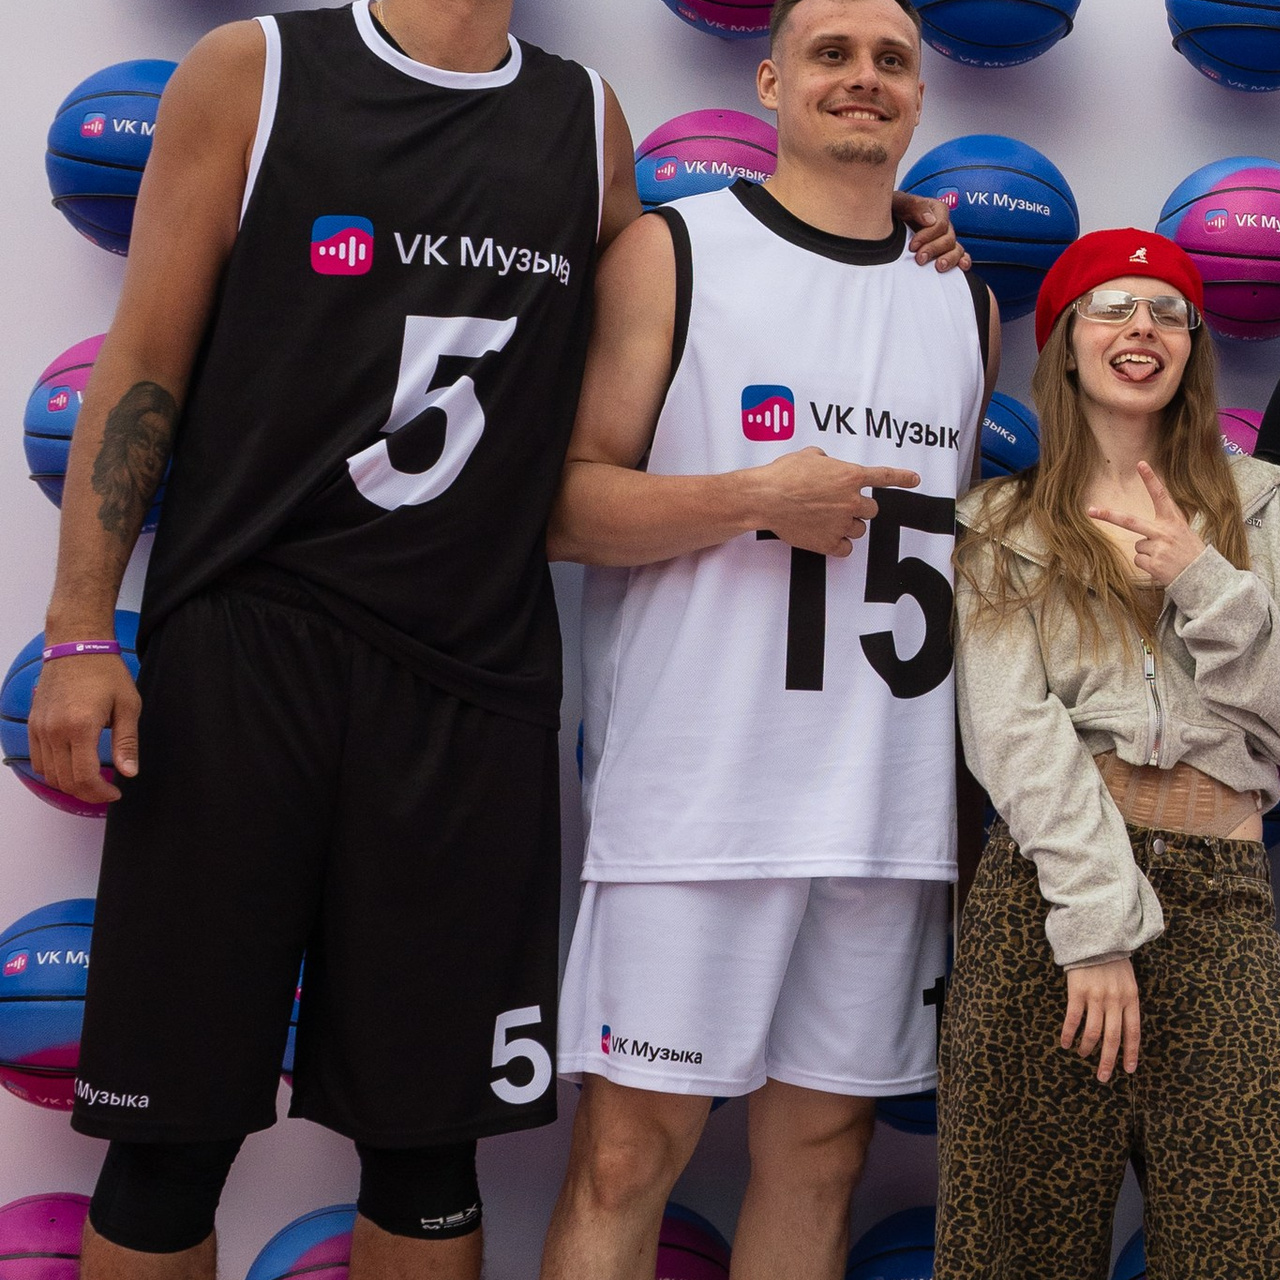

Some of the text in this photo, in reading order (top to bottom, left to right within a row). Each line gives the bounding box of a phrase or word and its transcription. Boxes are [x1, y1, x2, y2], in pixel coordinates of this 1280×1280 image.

[113, 119, 137, 134] VK
[684, 161, 707, 174] VK
[966, 191, 1051, 216] VK Музыка
[1235, 214, 1258, 227] VK
[393, 232, 571, 286] VK Музыка
[347, 314, 518, 512] 5
[809, 401, 960, 451] VK Музык
[982, 417, 1017, 444] зыка
[756, 486, 956, 700] 15
[36, 950, 61, 965] VK
[489, 1004, 553, 1105] 5
[612, 1035, 704, 1064] VK Музыка
[77, 1080, 150, 1108] Музыка
